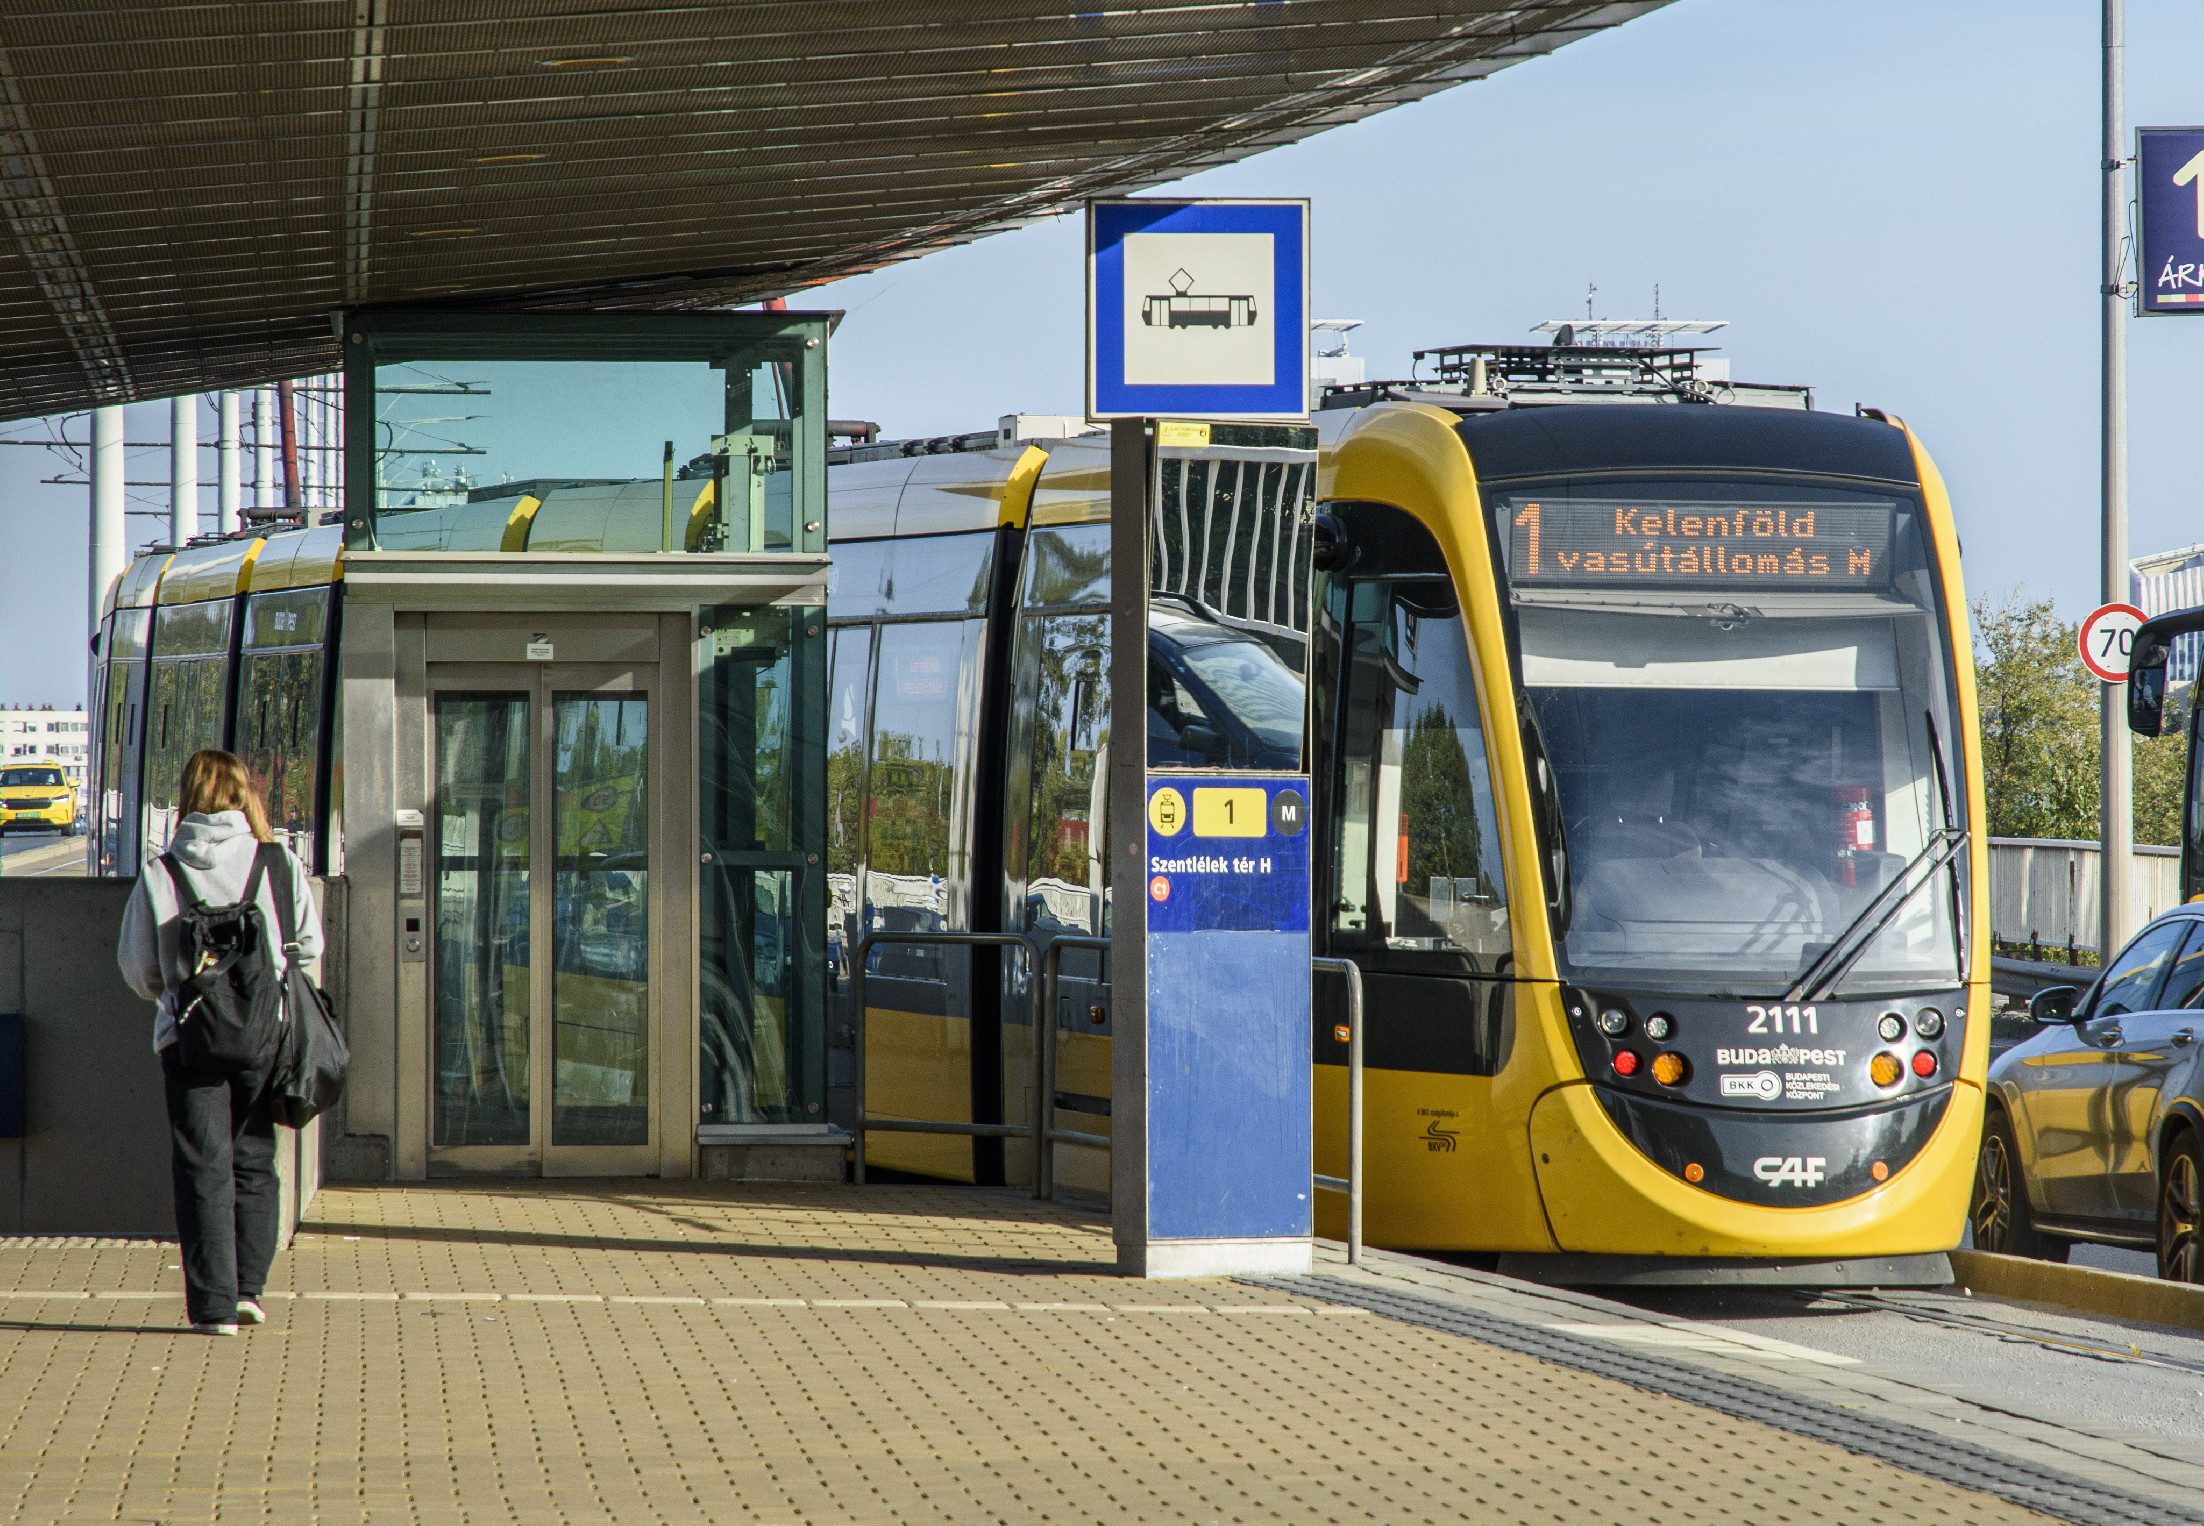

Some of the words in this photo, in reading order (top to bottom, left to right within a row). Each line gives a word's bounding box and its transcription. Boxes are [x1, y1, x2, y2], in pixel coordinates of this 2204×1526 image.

[1615, 508, 1815, 538] Kelenföld
[1515, 503, 1541, 575] 1
[1556, 542, 1831, 575] vasútállomás
[1848, 547, 1872, 576] M
[2099, 628, 2135, 658] 70
[1223, 799, 1235, 825] 1
[1281, 805, 1296, 822] M
[1151, 856, 1229, 873] Szentlélek
[1233, 857, 1255, 873] tér
[1260, 858, 1272, 873] H
[1153, 882, 1167, 895] C1
[1746, 1005, 1818, 1034] 2111
[1729, 1080, 1755, 1090] BKK
[1785, 1072, 1831, 1082] BUDAPESTI
[1785, 1081, 1841, 1091] KÖZLEKEDÉSI
[1786, 1090, 1825, 1100] KÖZPONT
[1753, 1156, 1827, 1188] CAF
